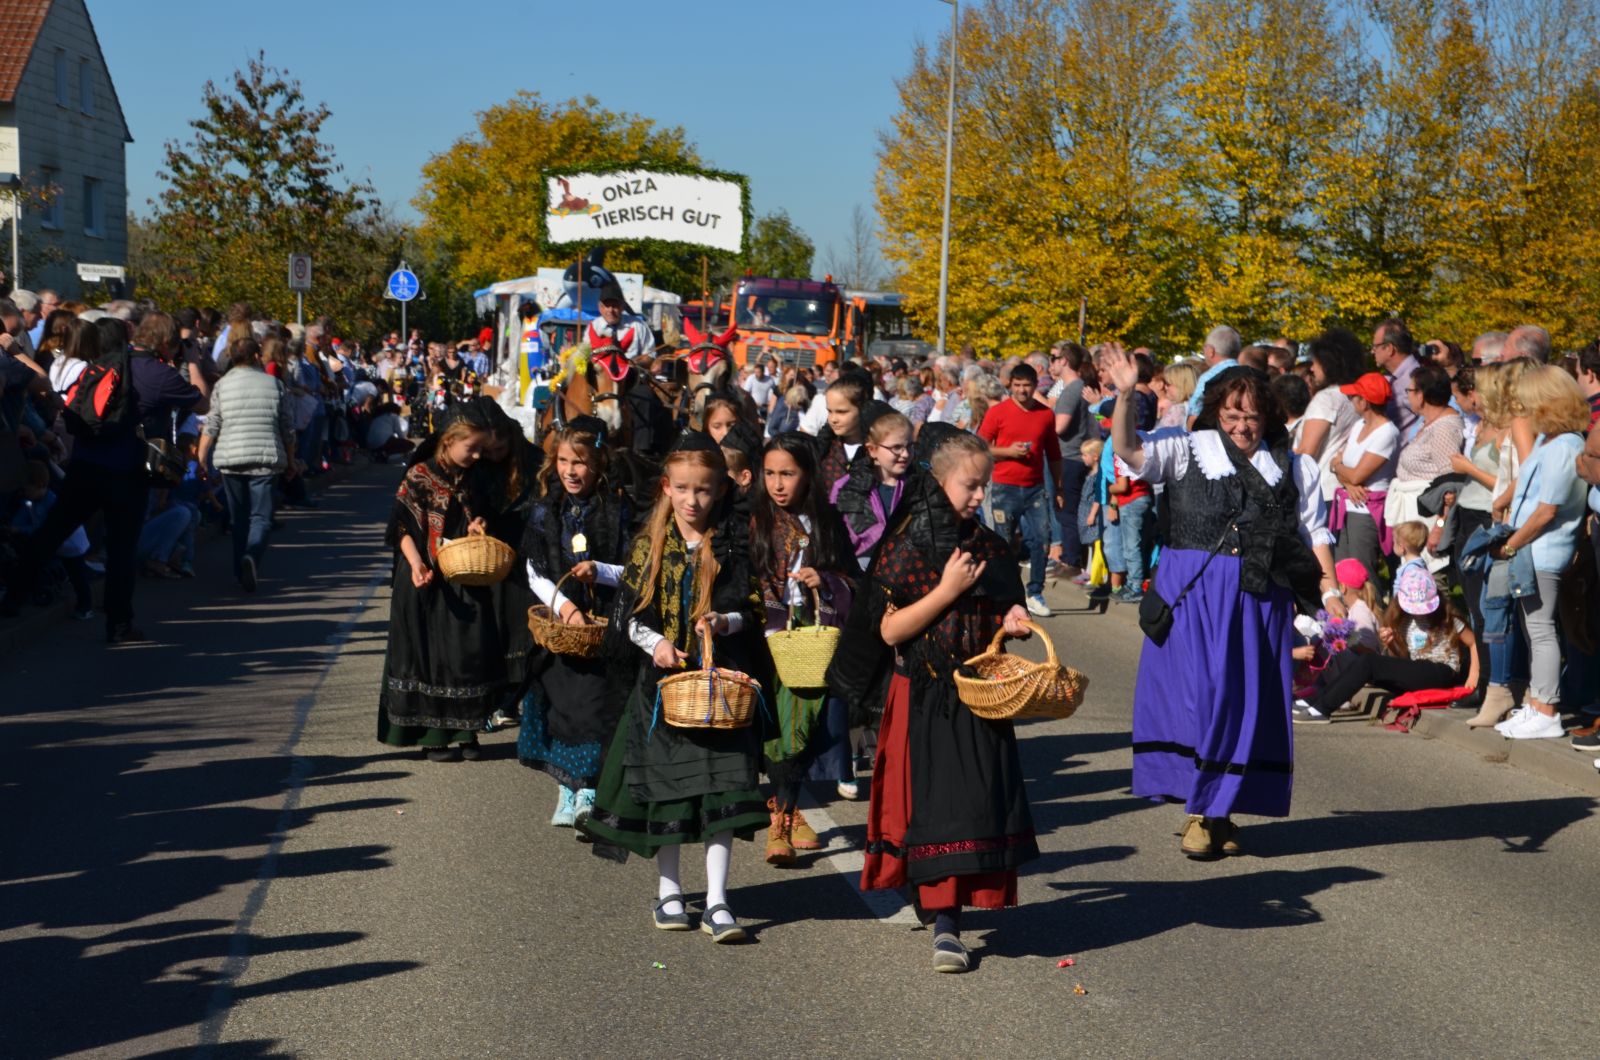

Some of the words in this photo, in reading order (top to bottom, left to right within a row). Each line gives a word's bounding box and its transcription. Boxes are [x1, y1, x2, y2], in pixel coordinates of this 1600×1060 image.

[602, 177, 658, 202] ONZA
[591, 205, 674, 230] TIERISCH
[682, 208, 722, 230] GUT
